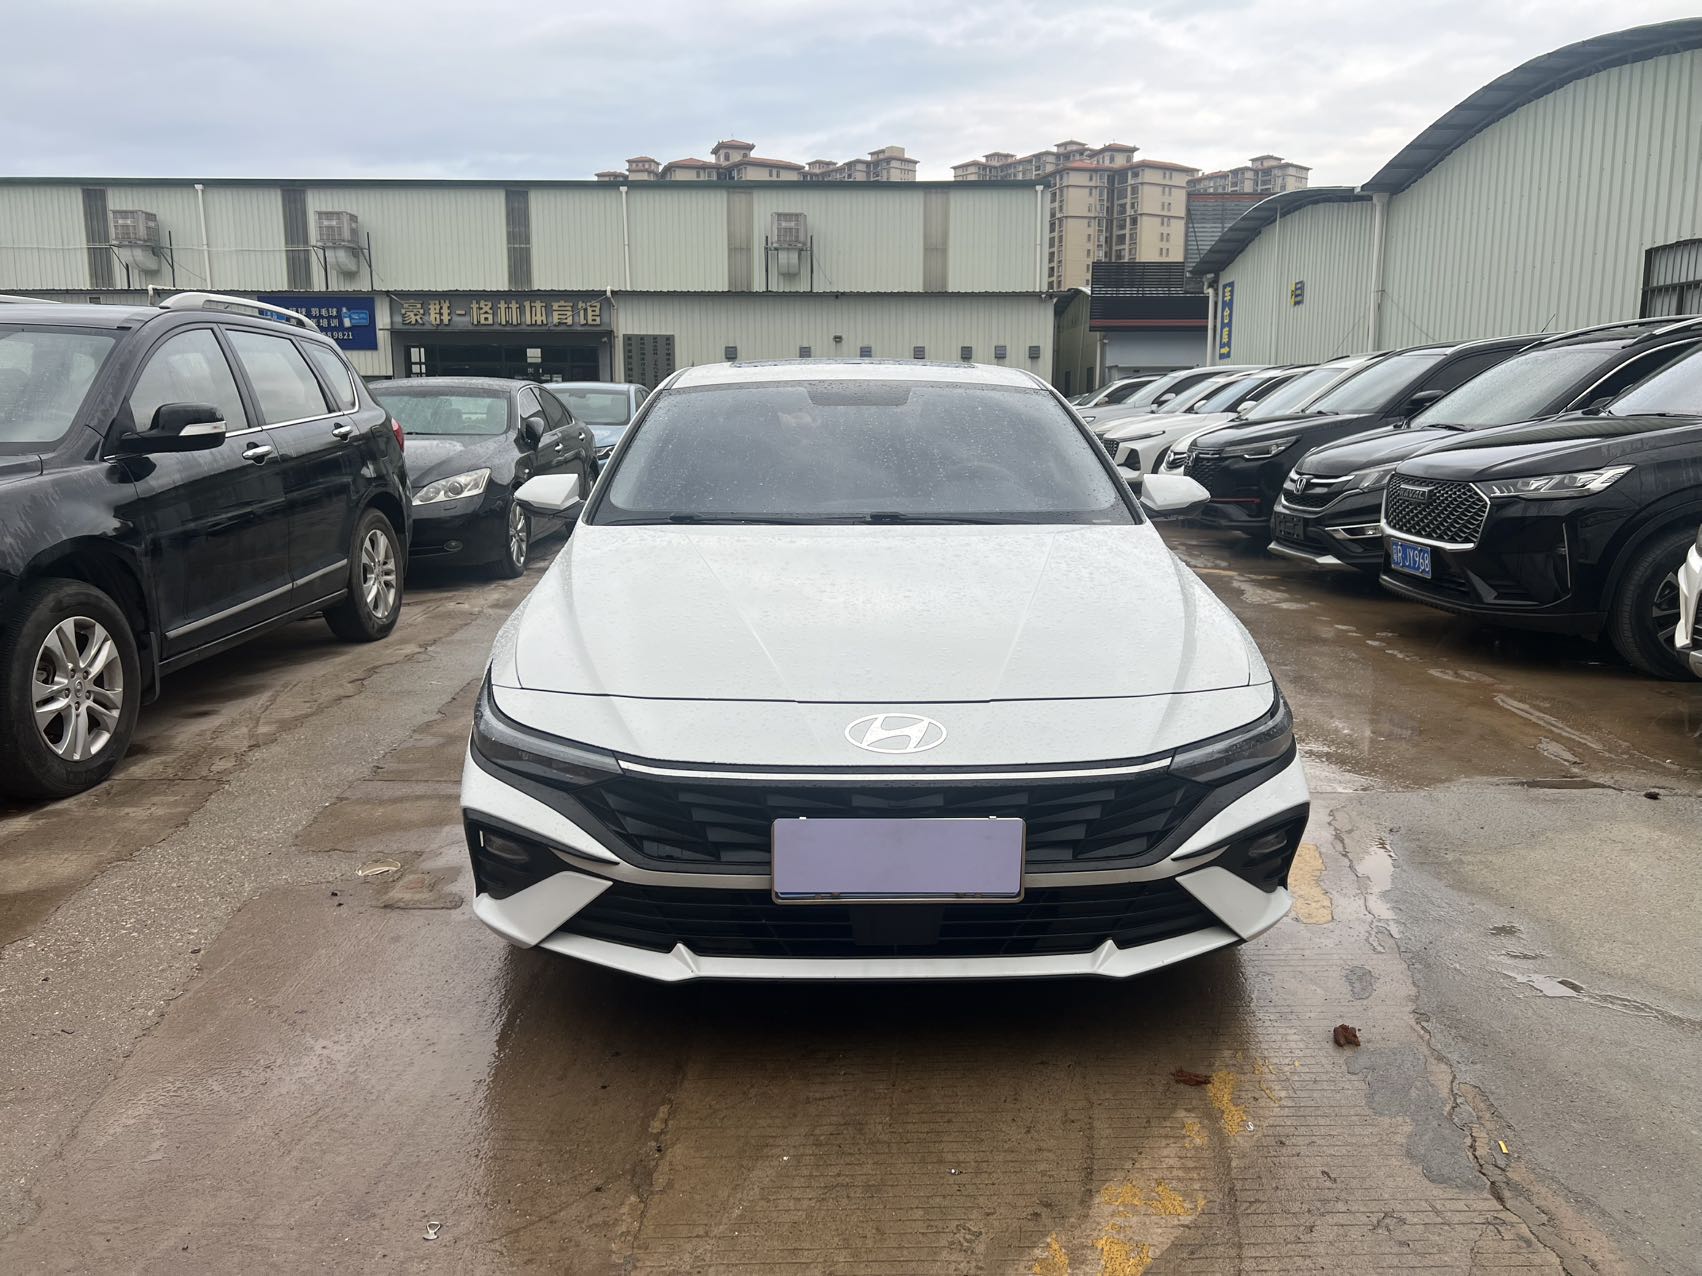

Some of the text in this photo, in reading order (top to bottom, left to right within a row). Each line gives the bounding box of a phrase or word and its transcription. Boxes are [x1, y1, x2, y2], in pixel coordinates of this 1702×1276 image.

[310, 307, 338, 317] 羽毛球
[400, 299, 602, 326] 豪群-格林体育馆
